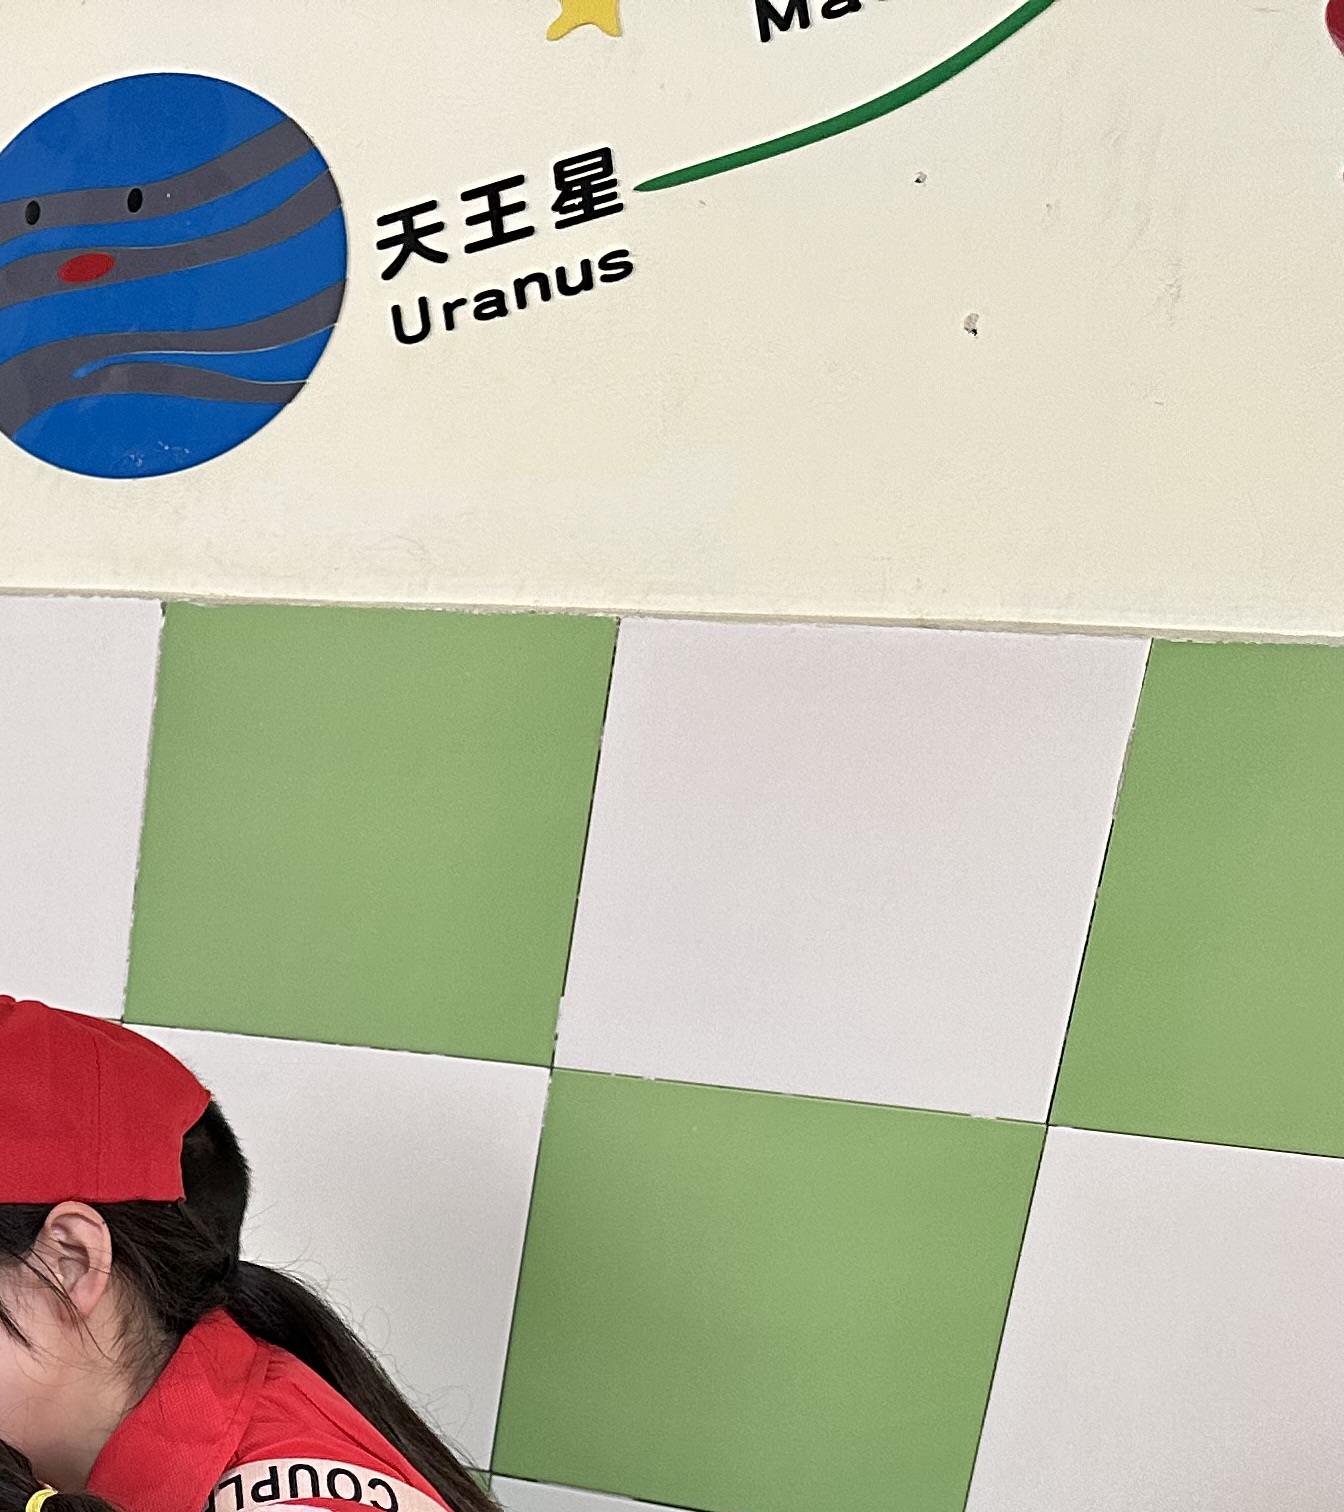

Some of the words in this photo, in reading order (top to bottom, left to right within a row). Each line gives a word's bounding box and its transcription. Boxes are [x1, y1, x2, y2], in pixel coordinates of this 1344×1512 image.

[376, 146, 624, 281] 天王星
[391, 249, 634, 344] Uranus
